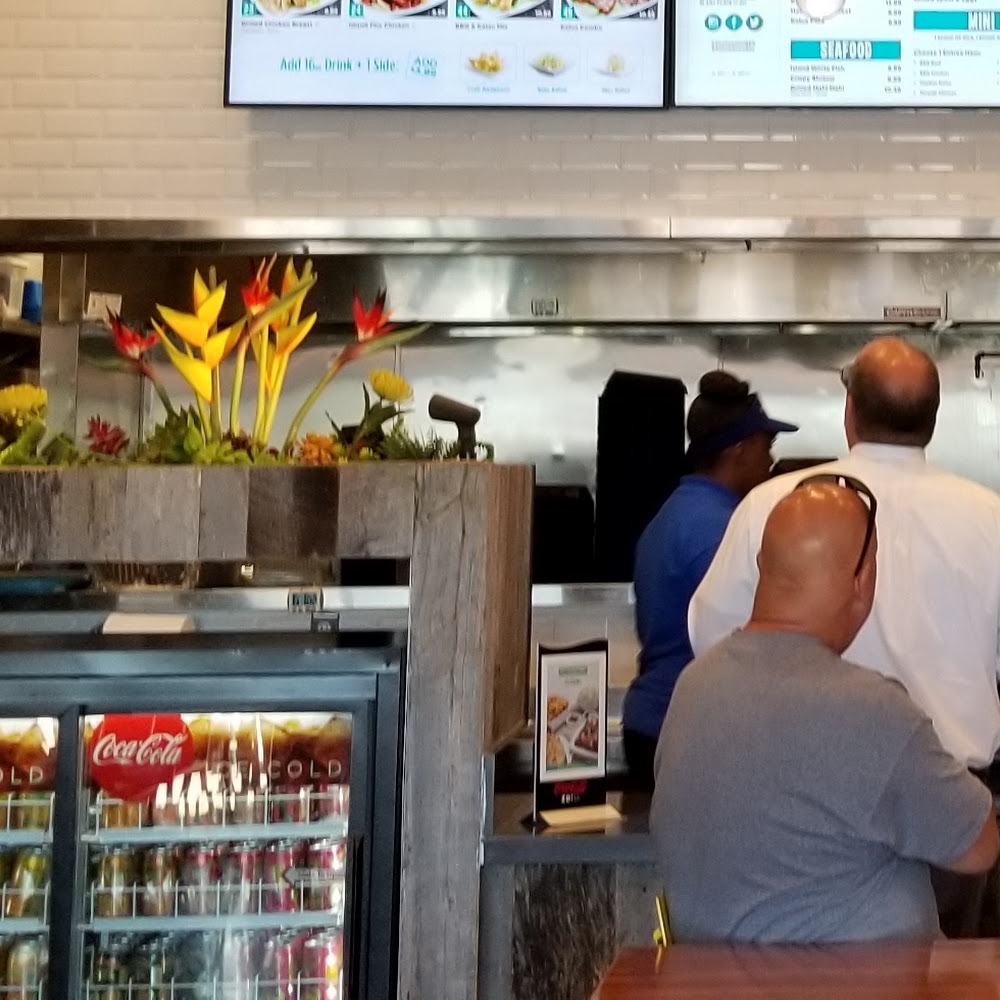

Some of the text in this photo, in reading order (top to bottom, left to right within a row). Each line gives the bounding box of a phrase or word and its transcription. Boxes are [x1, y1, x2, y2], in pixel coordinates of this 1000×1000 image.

[968, 11, 995, 30] MINI
[820, 41, 873, 58] SEAFOOD
[280, 56, 301, 72] Add
[325, 56, 352, 72] Drink
[92, 731, 189, 767] Coca-Cola
[270, 759, 342, 779] COLD
